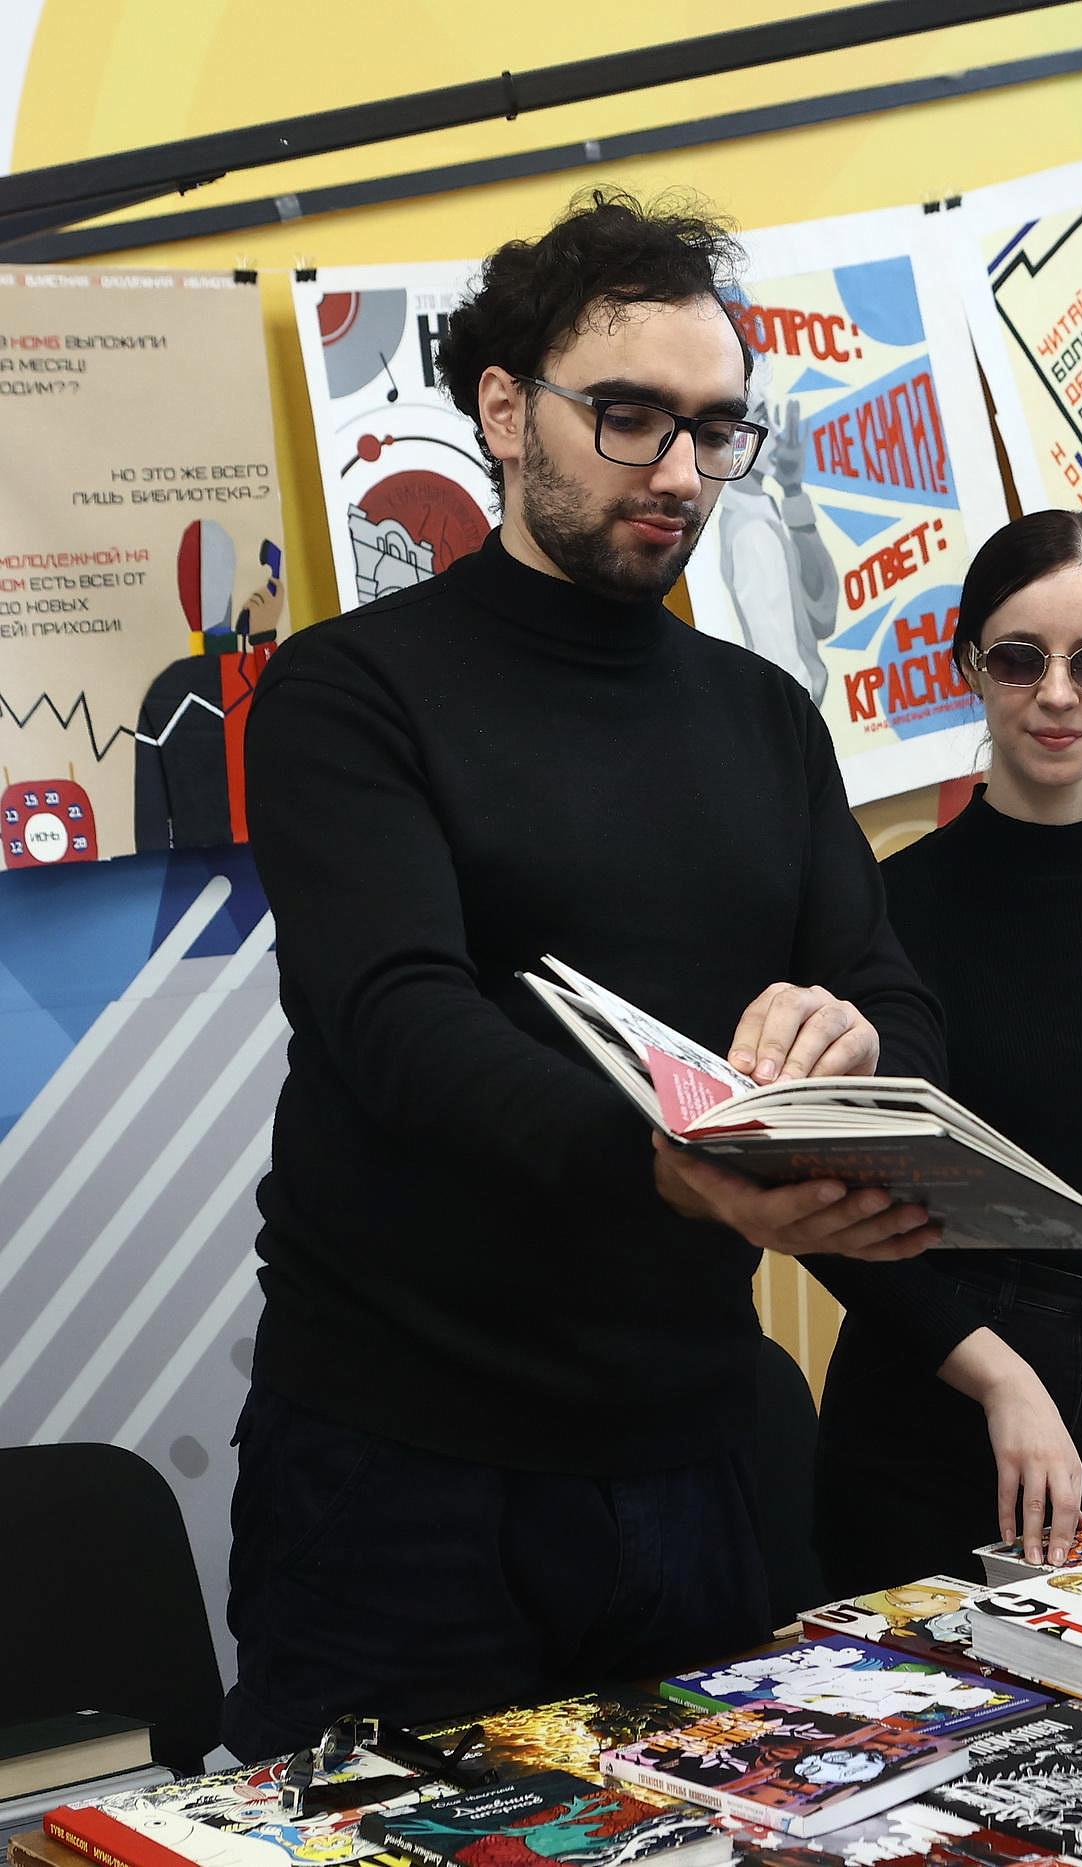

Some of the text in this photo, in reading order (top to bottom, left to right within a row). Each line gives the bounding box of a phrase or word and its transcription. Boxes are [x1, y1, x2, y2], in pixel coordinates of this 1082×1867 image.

[65, 335, 167, 350] ВЫЛОЖИЛИ
[111, 463, 269, 482] НО ЭТО ЖЕ ВСЕГО
[72, 491, 124, 505] ЛИШЬ
[126, 548, 149, 563] НА
[844, 518, 948, 611] ОТВЕТ:
[30, 577, 76, 592] ЕСТЬ
[124, 571, 147, 587] ОТ
[26, 598, 89, 613] НОВЫХ
[32, 618, 123, 637] ПРИХОДИ!
[93, 1846, 134, 1867] МУМИ-ТРО
